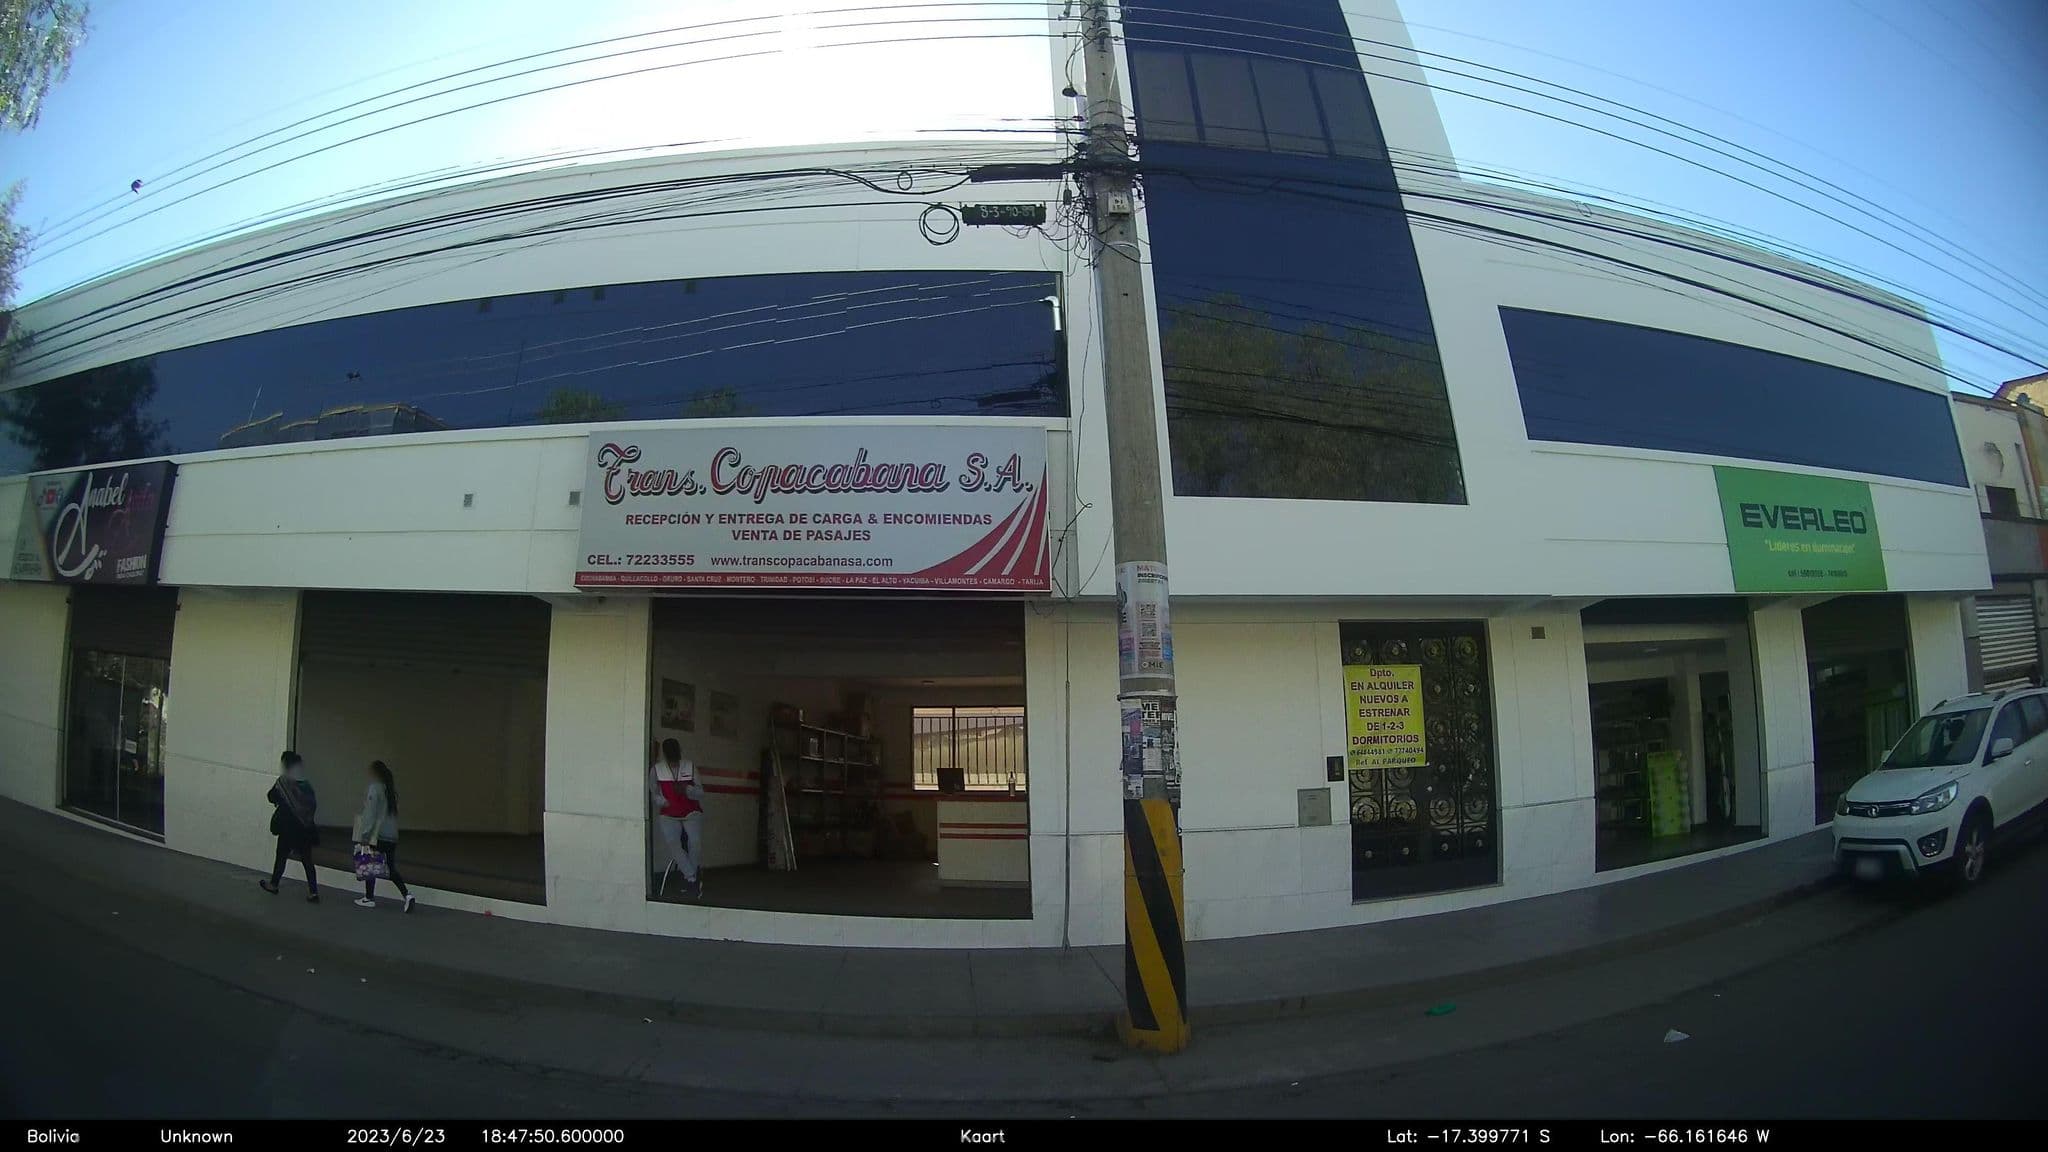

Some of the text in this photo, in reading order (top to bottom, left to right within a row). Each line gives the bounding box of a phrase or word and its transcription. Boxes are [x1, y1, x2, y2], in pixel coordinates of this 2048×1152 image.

[597, 442, 1034, 505] Trans. Copacabana S.A.
[625, 511, 993, 525] RECEPCIÓN Y ENTREGA DE CARGA & ENCOMIENDAS
[731, 529, 871, 541] VENTA DE PASAJES
[587, 555, 695, 566] CEL.: 72233555
[710, 555, 893, 568] www.transcopacabanasa.com
[687, 575, 705, 583] SANTA
[706, 575, 721, 583] CRUZ
[1370, 668, 1394, 678] Dpto.
[1350, 681, 1414, 690] EN ALQUILER
[1360, 695, 1409, 704] NUEVOS A
[1359, 708, 1410, 717] ESTRENAR
[1367, 721, 1405, 731] DE 1-2-3
[1352, 735, 1419, 745] DORMITORIOS
[1382, 757, 1416, 765] PARQUEO
